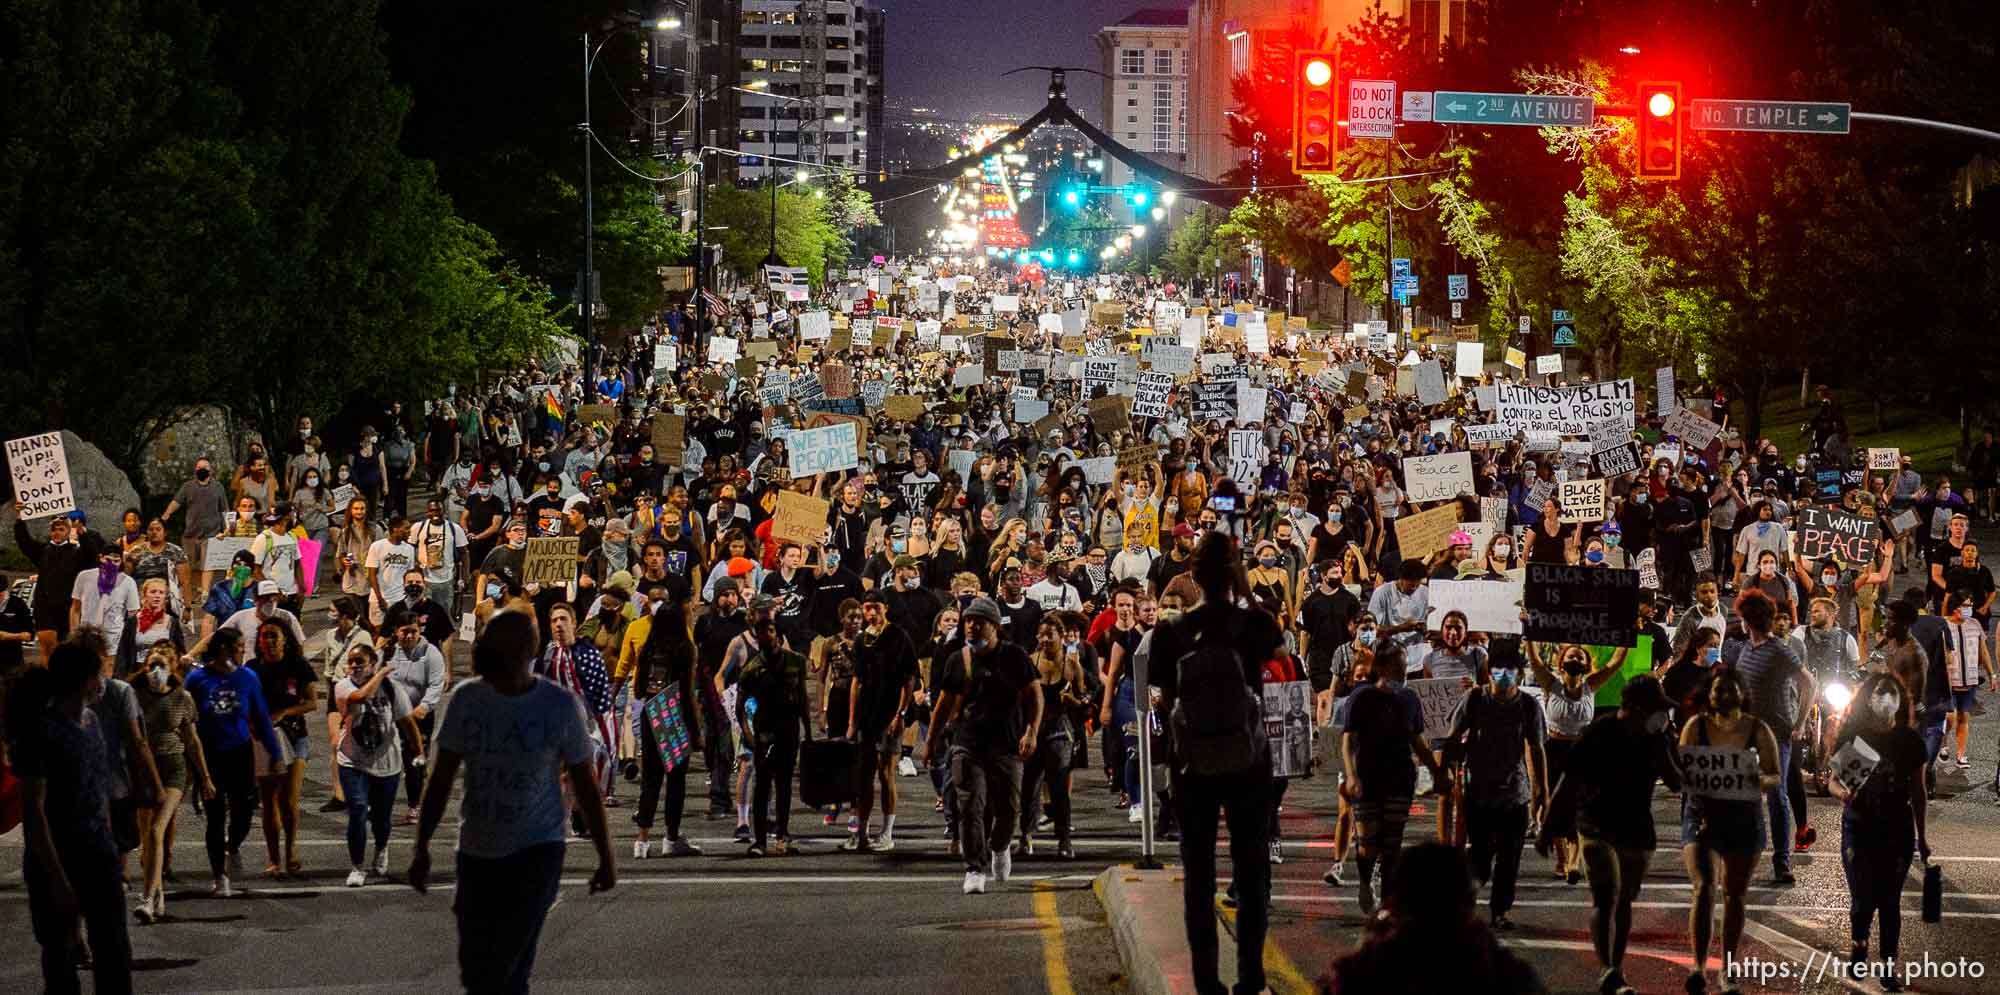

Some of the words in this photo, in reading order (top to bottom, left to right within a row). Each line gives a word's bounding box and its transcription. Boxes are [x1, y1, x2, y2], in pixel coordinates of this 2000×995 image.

[1352, 88, 1367, 101] DO
[1370, 88, 1393, 102] NOT
[1351, 106, 1393, 120] BLOCK
[1511, 102, 1582, 122] AVENUE
[1701, 108, 1725, 123] No.
[1734, 107, 1809, 126] TEMPLE
[1350, 122, 1392, 133] INTERSECTION
[1451, 287, 1467, 297] 30
[1139, 371, 1171, 384] PUERTO
[1199, 392, 1226, 400] SILENCE
[1132, 401, 1165, 417] LIVES!
[790, 430, 817, 450] WE
[823, 425, 856, 448] THE
[1470, 427, 1513, 440] MATTER!
[8, 434, 59, 458] HANDS
[1231, 432, 1263, 459] FUCK
[794, 446, 857, 474] PEOPLE
[1874, 460, 1895, 468] SHOOT
[1413, 463, 1461, 476] Peace
[1564, 483, 1602, 497] BLACK
[24, 496, 72, 516] SHOOT!
[1564, 495, 1601, 506] LIVES
[1560, 507, 1602, 518] MATTER
[1805, 509, 1819, 526] I
[1827, 513, 1874, 538] WANT
[1802, 528, 1870, 563] PEACE
[1532, 566, 1585, 584] BLACK
[1592, 569, 1632, 586] SKIN
[1546, 588, 1560, 603] IS
[1528, 608, 1608, 629] PROBABLE
